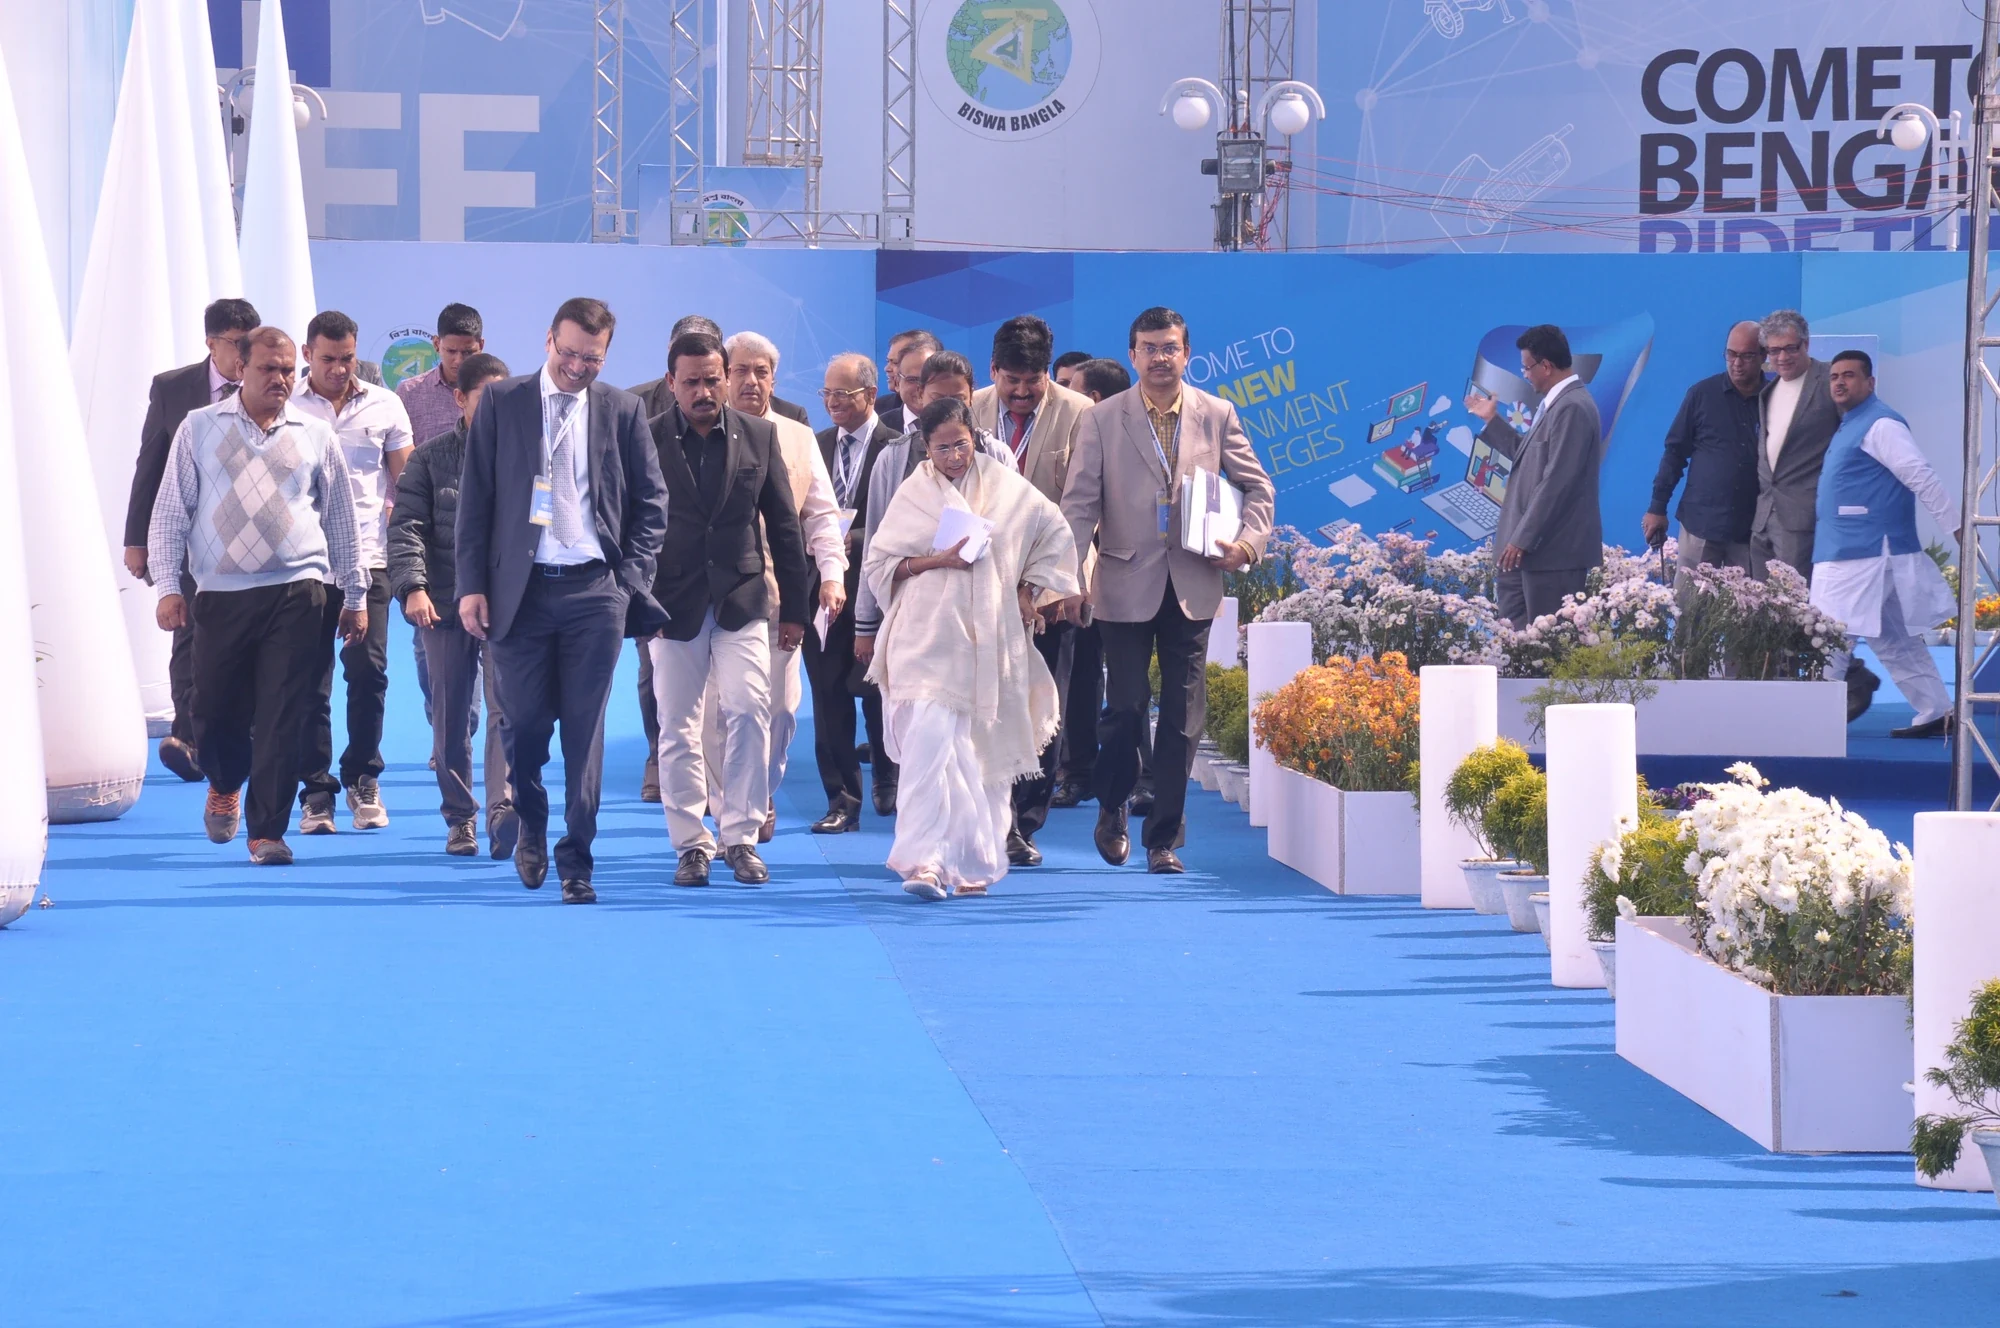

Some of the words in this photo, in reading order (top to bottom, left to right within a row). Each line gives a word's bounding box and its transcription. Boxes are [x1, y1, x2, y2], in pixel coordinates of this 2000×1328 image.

[1640, 45, 1904, 125] COME
[957, 101, 1006, 132] BISWA
[1010, 98, 1066, 132] BANGLA
[1639, 130, 2000, 214] BENGA
[411, 328, 434, 340] বাংল
[1253, 326, 1295, 359] TO
[1216, 359, 1296, 409] NEW
[1242, 379, 1350, 445] NMENT
